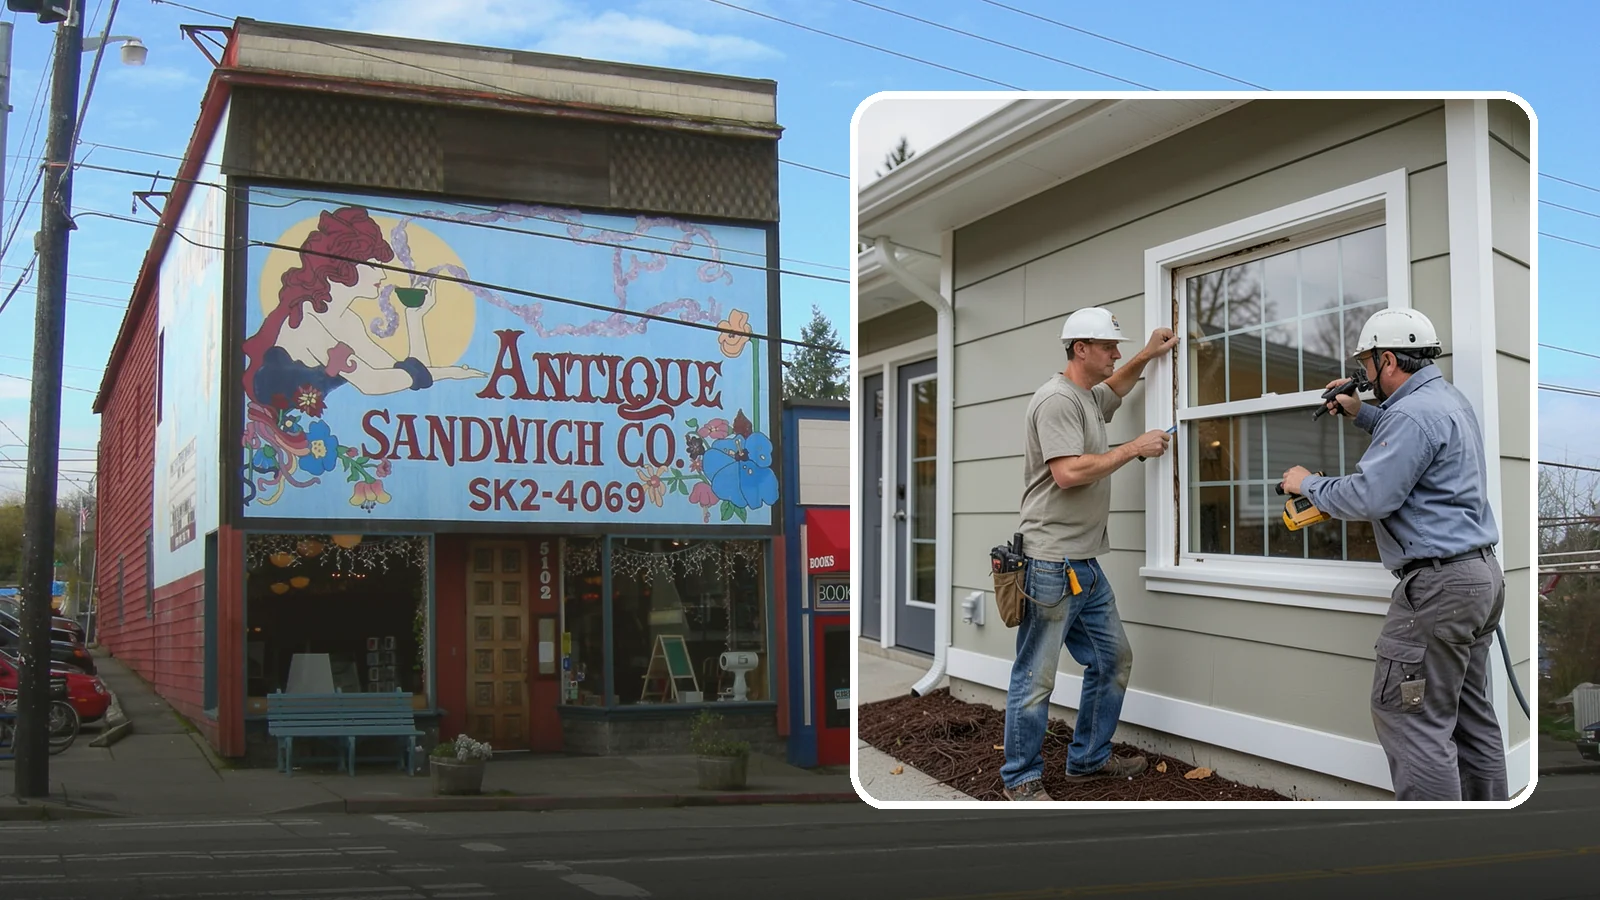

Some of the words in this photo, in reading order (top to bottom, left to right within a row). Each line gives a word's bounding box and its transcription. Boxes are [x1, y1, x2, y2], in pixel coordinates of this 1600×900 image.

[475, 328, 724, 421] ANTIQUE
[361, 408, 605, 467] SANDWICH
[617, 420, 685, 469] CO.
[468, 477, 646, 512] SK2-4069
[539, 541, 552, 600] 5102
[809, 555, 835, 569] BOOKS
